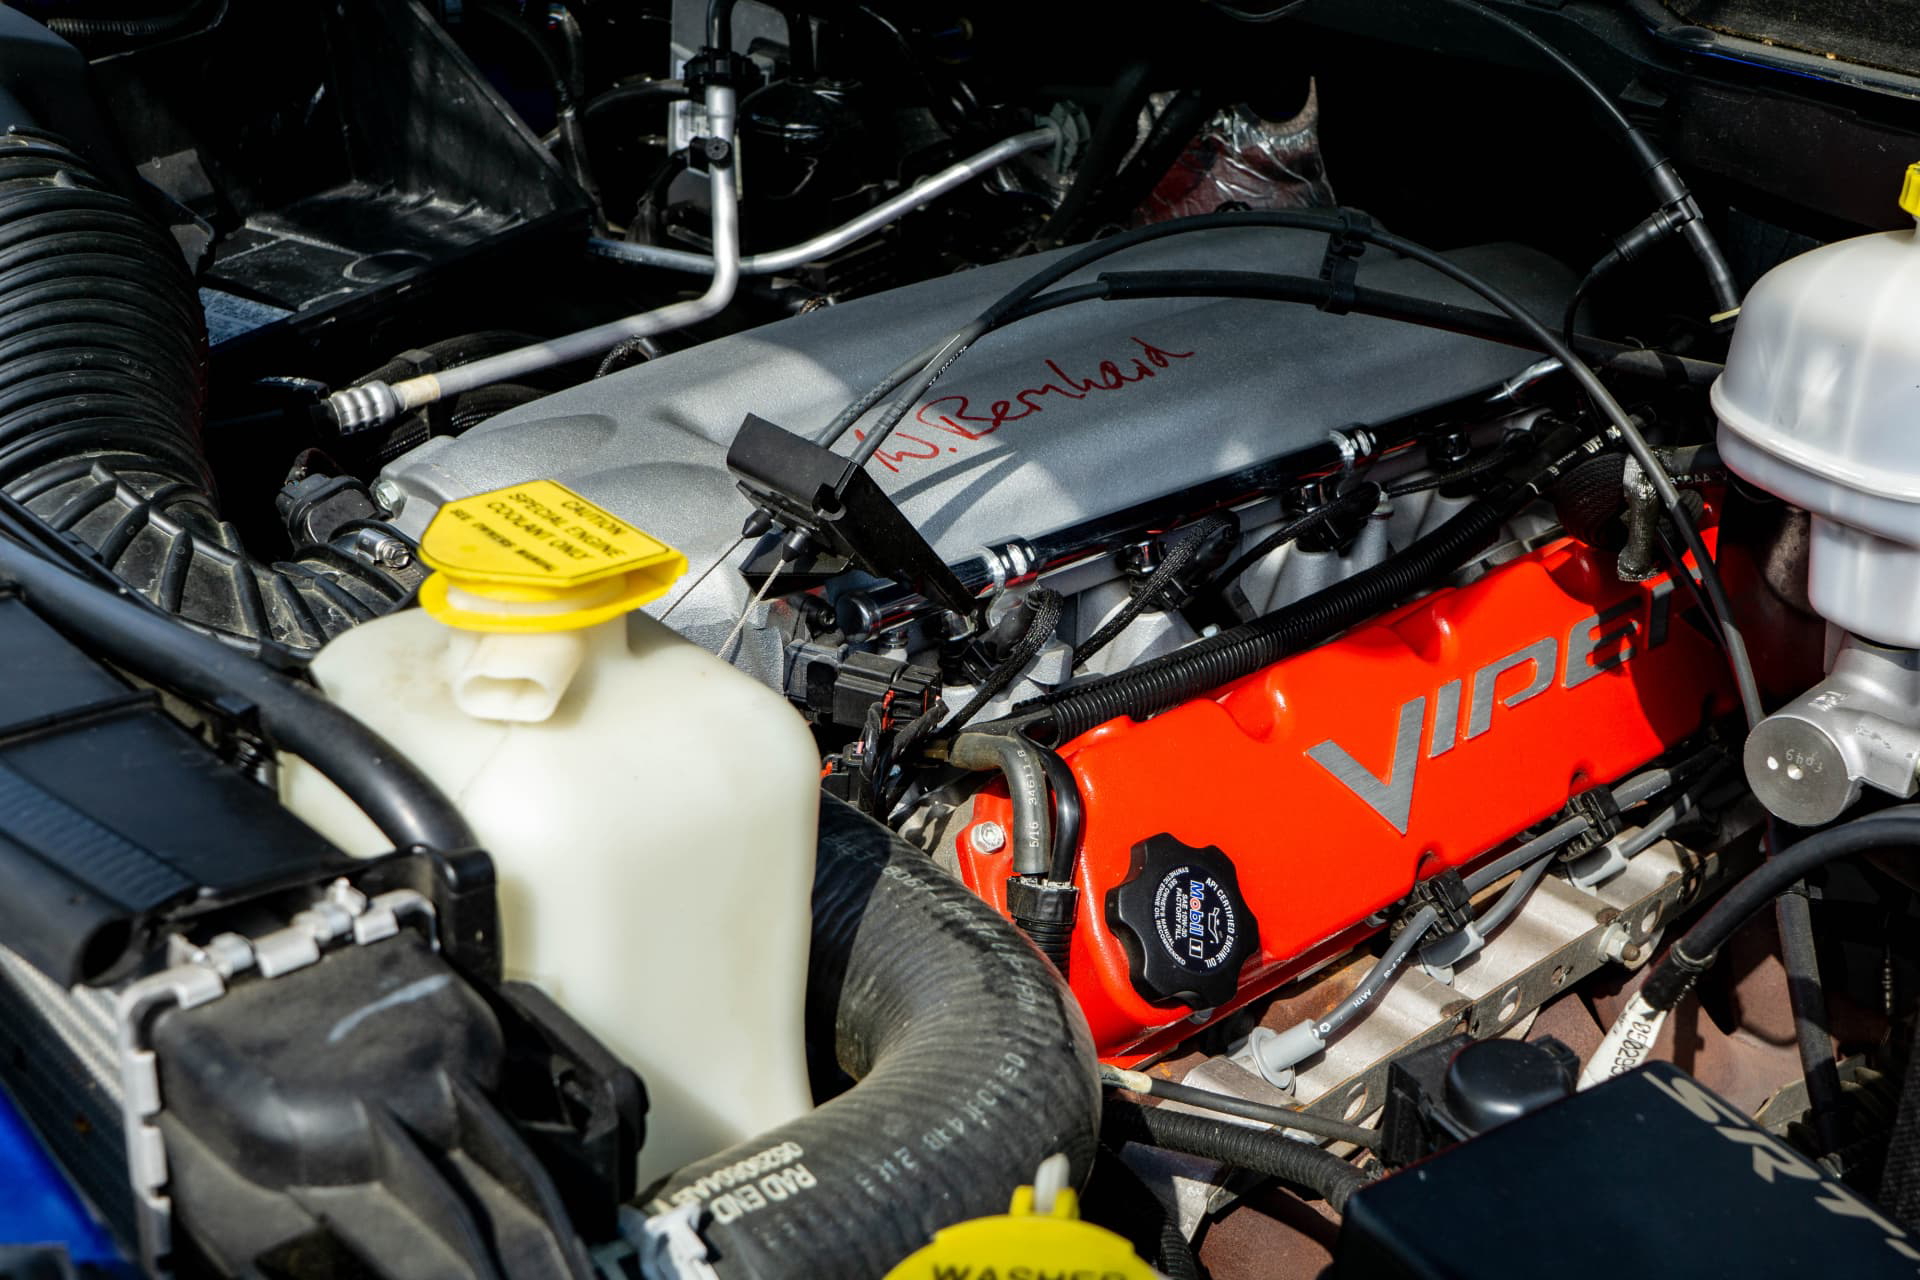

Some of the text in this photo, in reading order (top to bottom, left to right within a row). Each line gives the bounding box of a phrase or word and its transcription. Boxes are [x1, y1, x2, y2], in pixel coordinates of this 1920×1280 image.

[487, 501, 595, 560] COOLANT ONLY
[508, 492, 627, 559] SPECIAL ENGINE
[560, 500, 628, 536] CAUTION
[1028, 821, 1039, 848] 5/16
[1154, 882, 1166, 906] ENGINE
[1163, 866, 1189, 885] SYNTHETIC
[1167, 878, 1178, 890] SEE
[1189, 879, 1204, 937] Mobil
[1204, 877, 1235, 969] API CERTIFIED ENGINE OIL
[1155, 919, 1186, 966] RECOMMENDED
[1161, 918, 1175, 947] MANUAL
[759, 1163, 818, 1201] RAD
